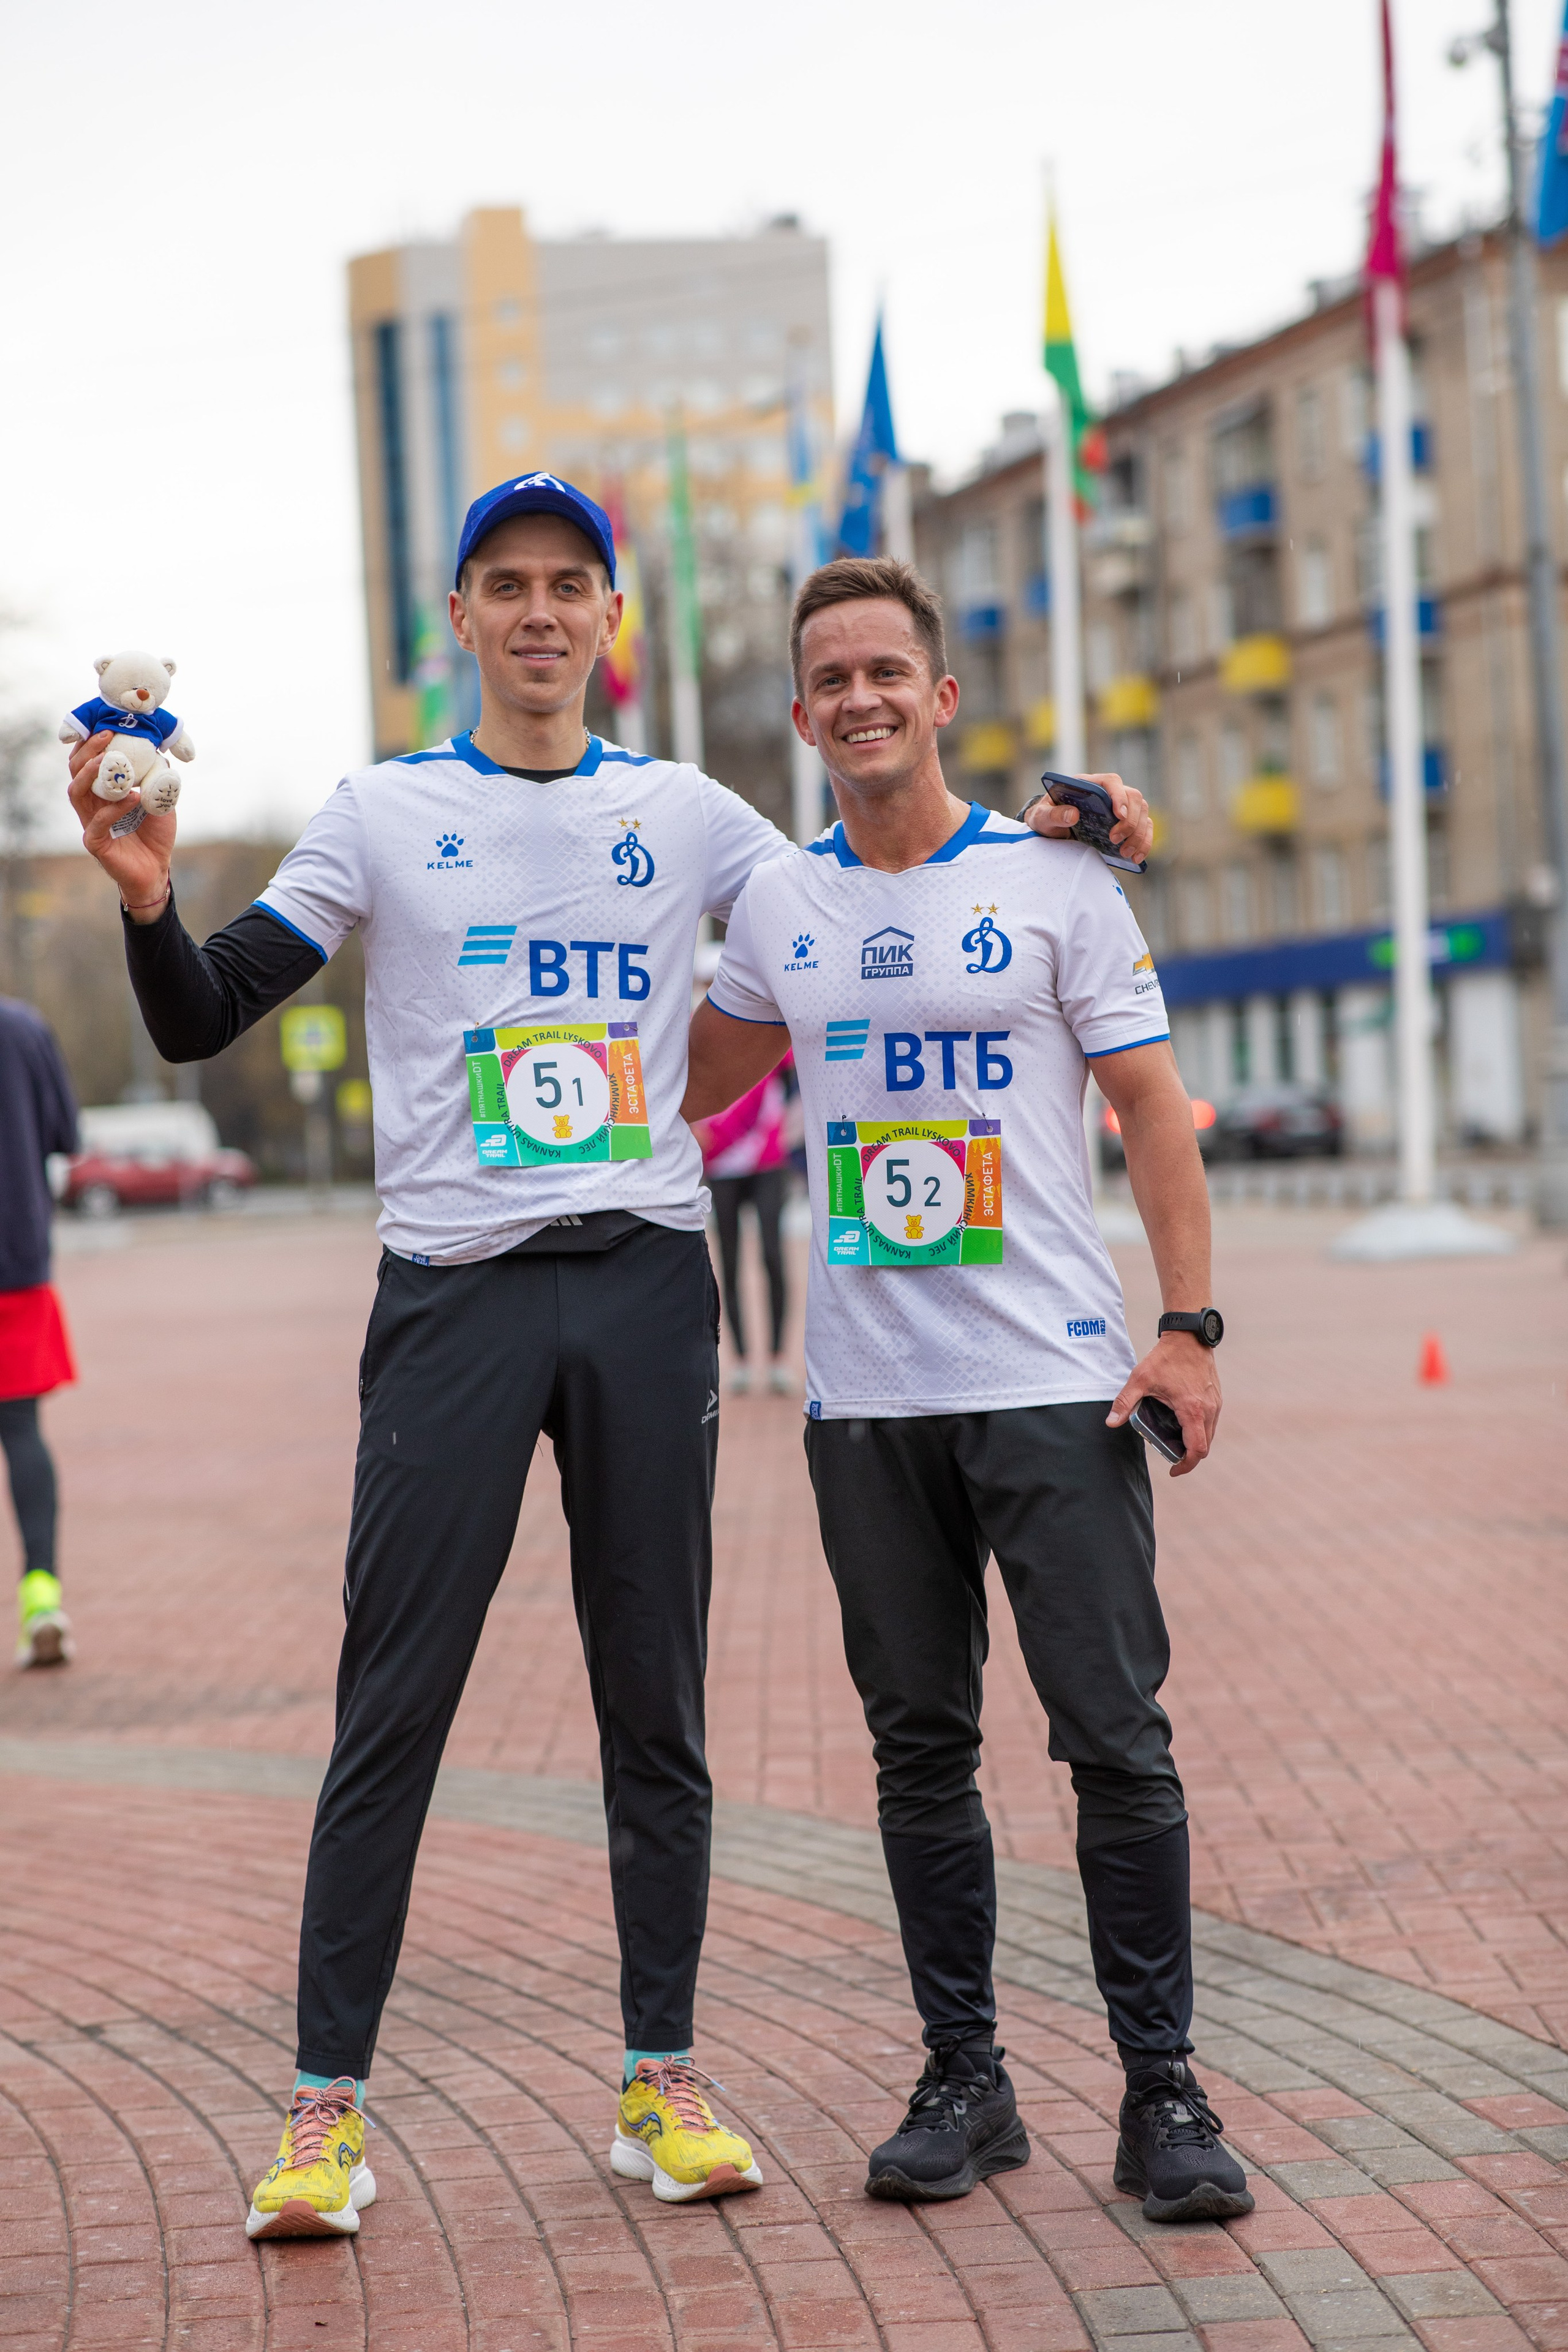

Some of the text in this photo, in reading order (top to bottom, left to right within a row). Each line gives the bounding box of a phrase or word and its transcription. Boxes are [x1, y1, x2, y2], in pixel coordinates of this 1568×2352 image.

[427, 860, 473, 870] KELME
[529, 940, 650, 1001] ВТБ
[784, 961, 818, 971] KELME
[861, 943, 914, 965] ПИК
[865, 966, 910, 977] ГРУППА
[503, 1031, 602, 1068] DREAM TRAIL LYSKOVO
[884, 1030, 1013, 1092] ВТБ
[496, 1082, 507, 1110] TRAIL
[533, 1061, 584, 1109] 5 1
[623, 1053, 639, 1114] ЭСТАФЕТА
[578, 1073, 620, 1155] ХИМКИНСКИЙ ЛЕС
[521, 1137, 561, 1158] KANNAS
[863, 1127, 960, 1163] DREAM TRAIL LYSKOVO
[854, 1177, 863, 1205] TRAIL
[886, 1159, 941, 1207] 5 2
[982, 1152, 994, 1216] ЭСТАФЕТА
[928, 1172, 975, 1257] ХИМКИНСКИЙ ЛЕС
[873, 1235, 911, 1259] KANNAS
[1066, 1320, 1100, 1336] FCDM
